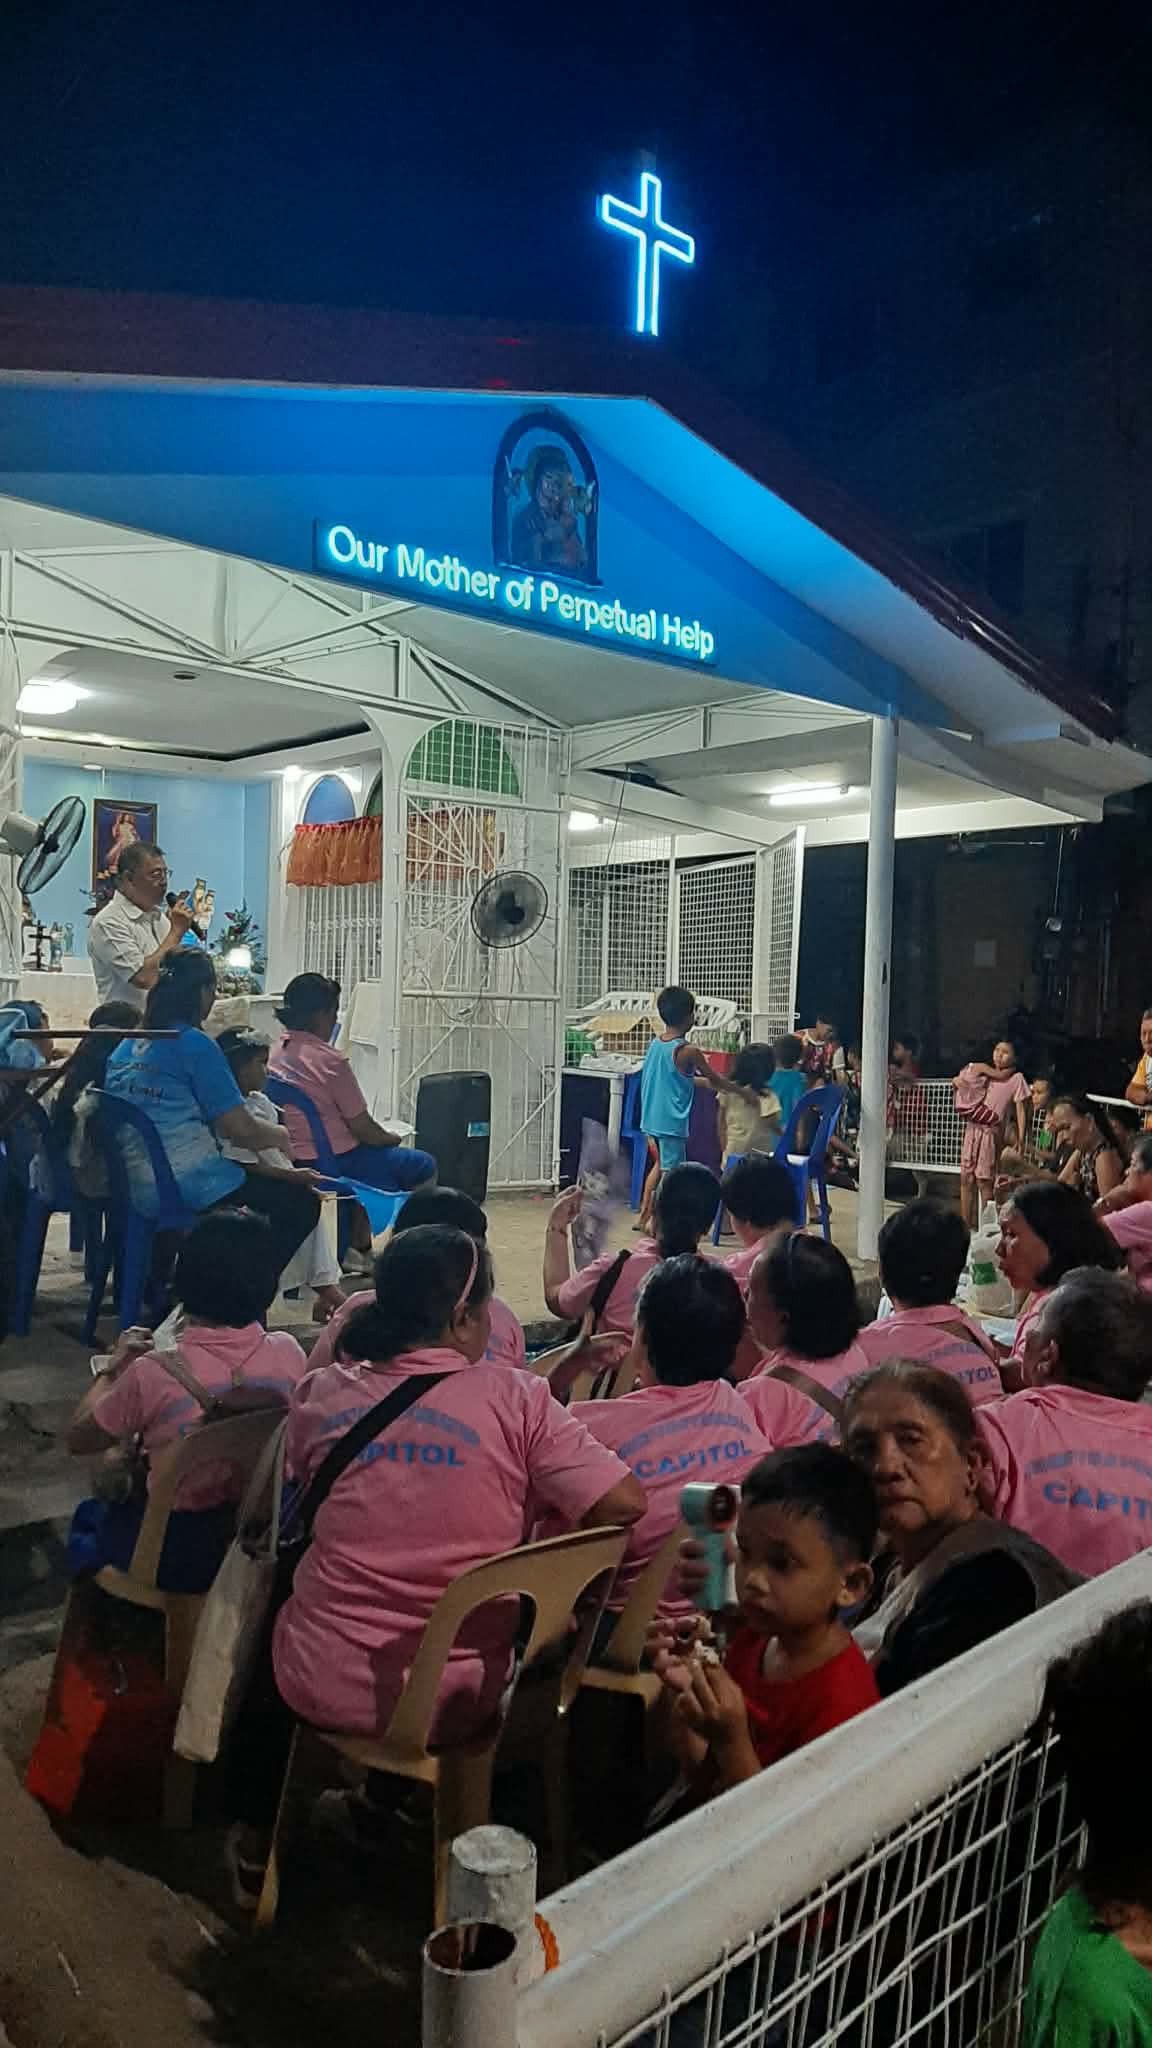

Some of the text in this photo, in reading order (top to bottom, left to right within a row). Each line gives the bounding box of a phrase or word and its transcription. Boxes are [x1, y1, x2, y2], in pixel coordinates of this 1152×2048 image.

[328, 525, 715, 658] Our Mother of Perpetual Help
[634, 1439, 753, 1479] CAPITOL
[1043, 1482, 1152, 1521] CAPIT
